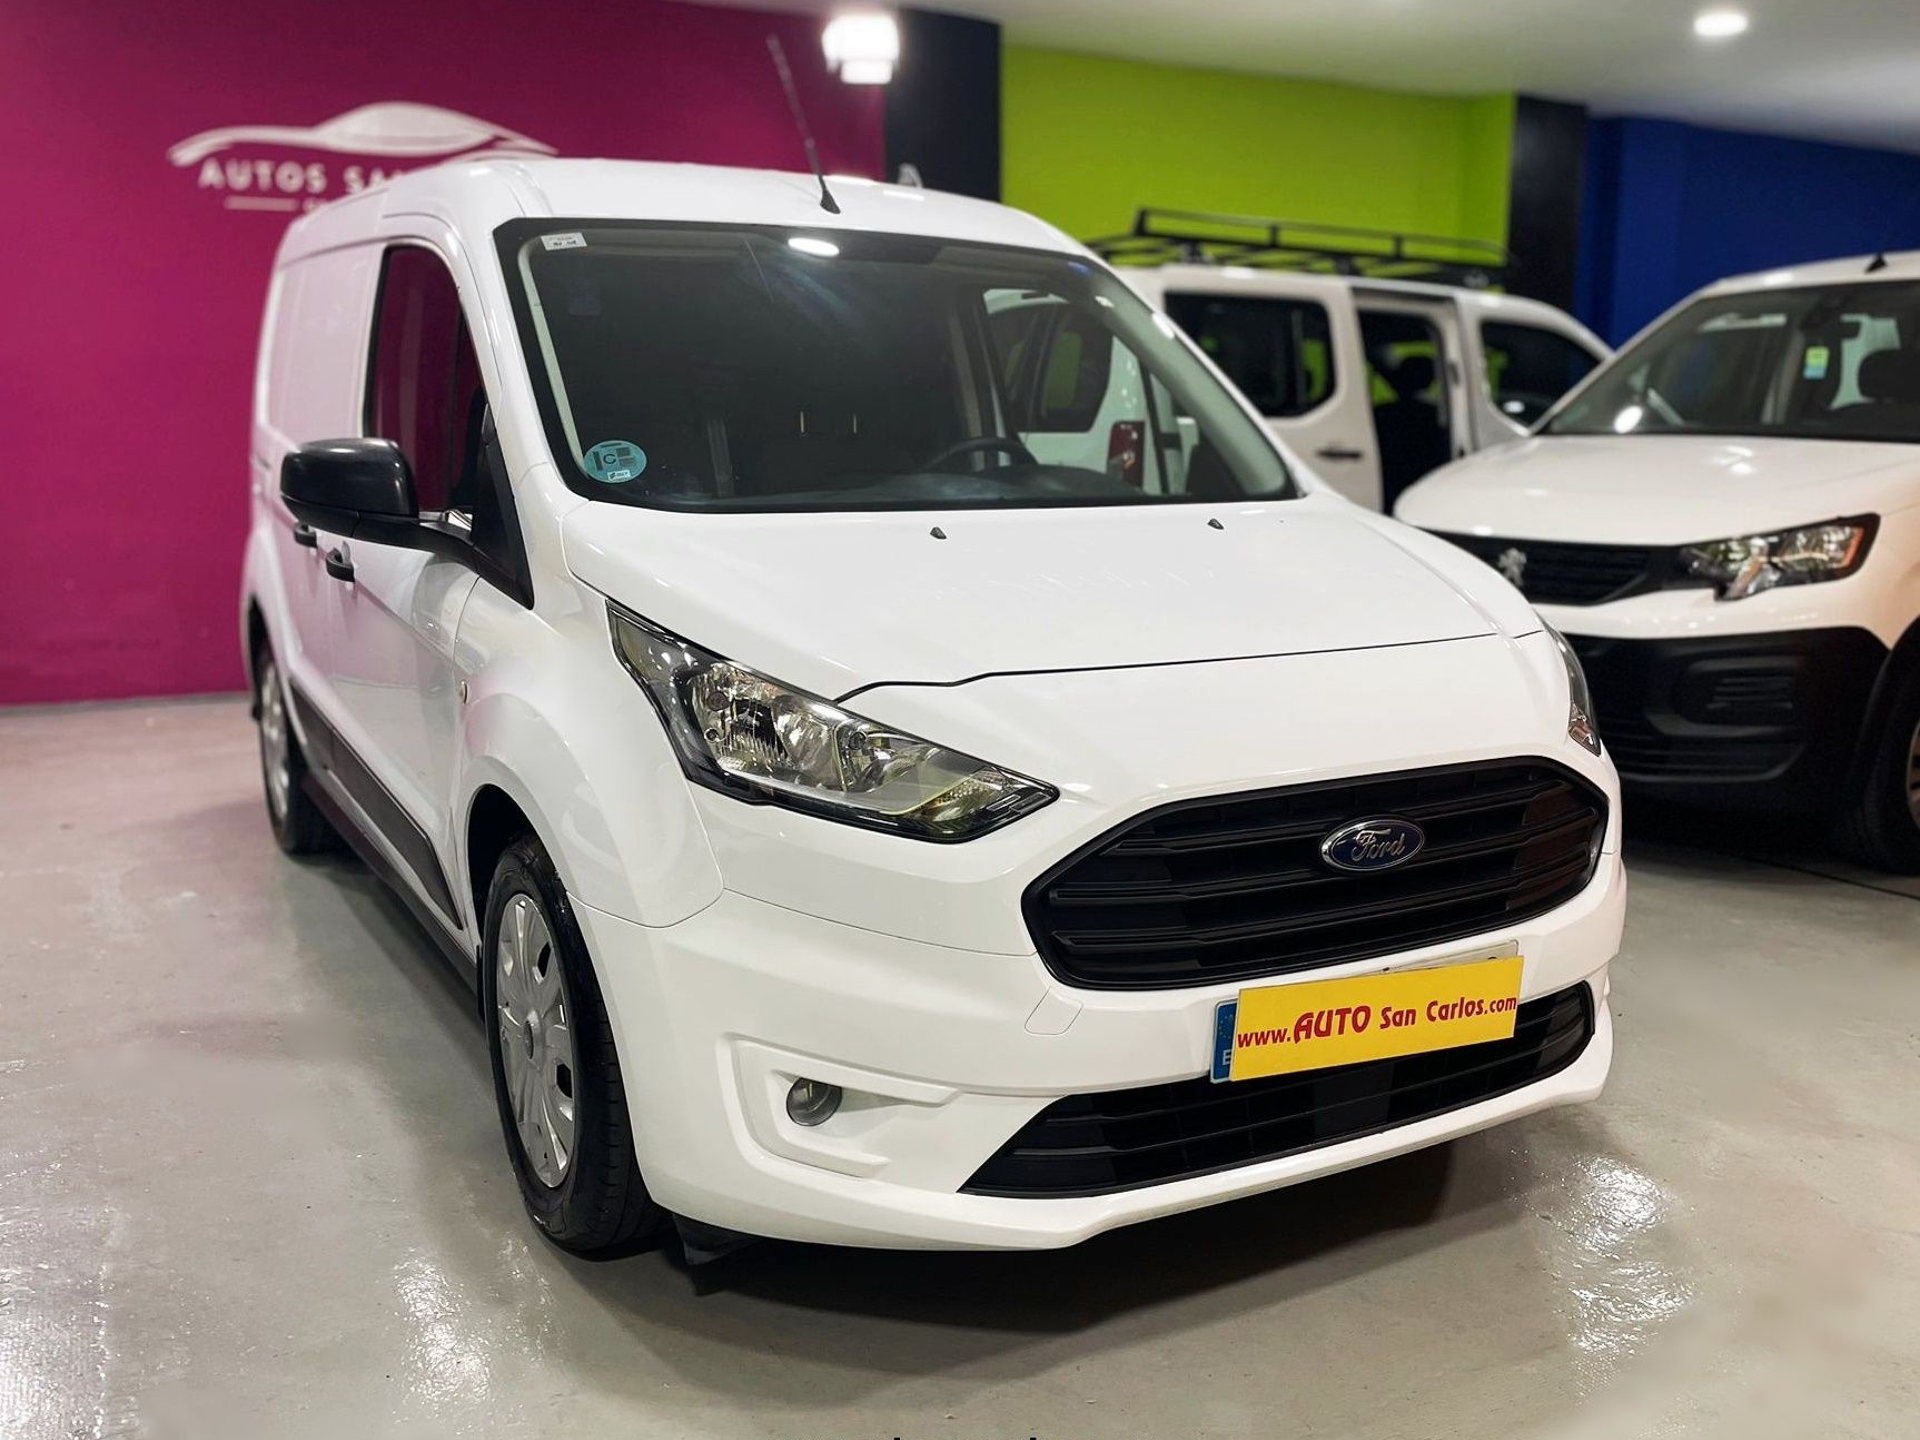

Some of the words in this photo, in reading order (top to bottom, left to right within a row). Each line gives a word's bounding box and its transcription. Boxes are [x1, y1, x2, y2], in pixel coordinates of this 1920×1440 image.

[198, 158, 327, 193] AUTOS
[343, 165, 407, 194] SA
[1350, 828, 1406, 861] Ford
[1380, 1006, 1417, 1030] San
[1426, 996, 1518, 1023] Carlos.com
